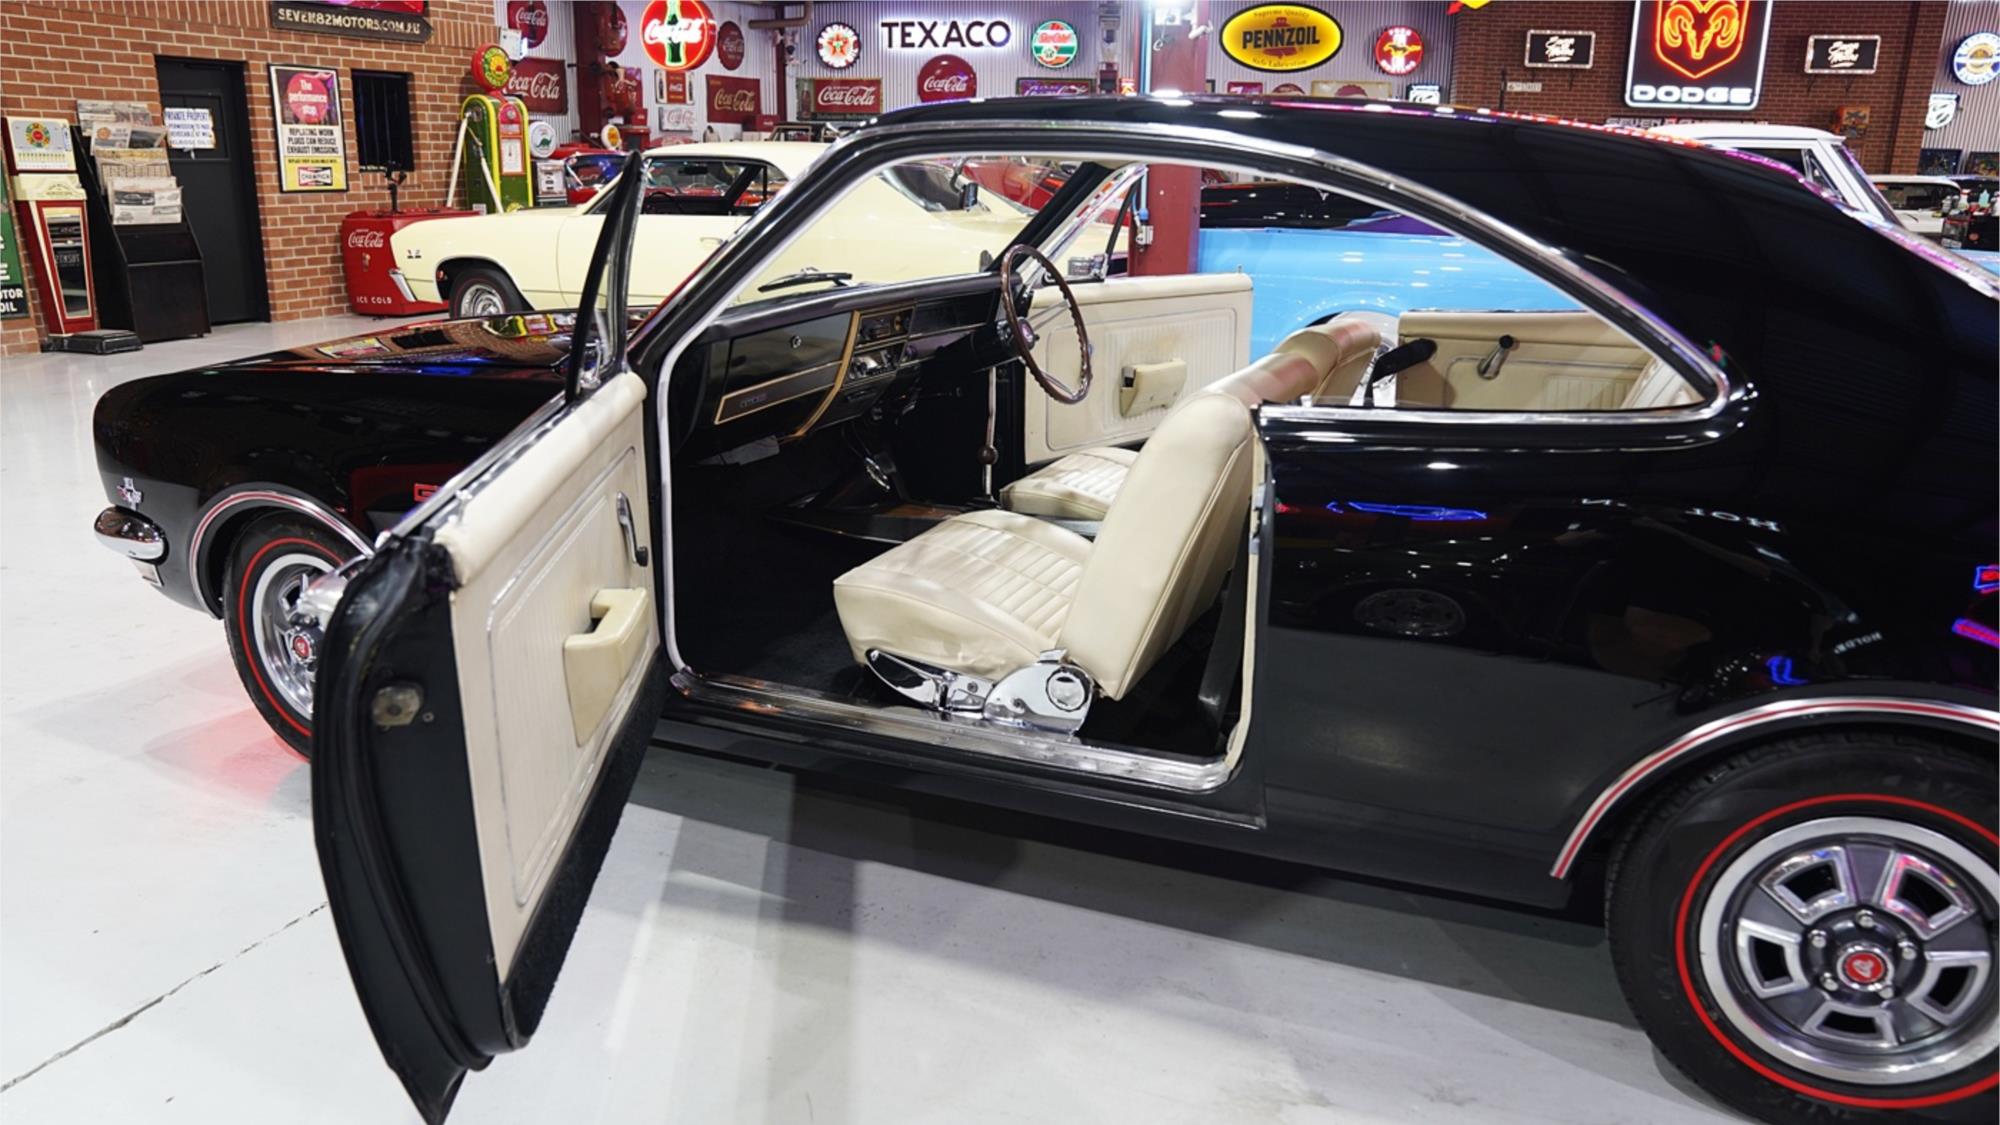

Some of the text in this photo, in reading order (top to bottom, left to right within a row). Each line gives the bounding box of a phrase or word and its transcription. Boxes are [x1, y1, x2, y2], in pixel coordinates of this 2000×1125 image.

[881, 20, 1011, 48] TEXACO
[1242, 25, 1320, 49] PENNZOIL
[923, 75, 968, 92] Coca-Cola
[714, 88, 755, 112] Coca-Cola
[817, 86, 876, 106] Coca-Cola
[1633, 84, 1753, 104] DODGE
[357, 296, 392, 304] ICE COLD
